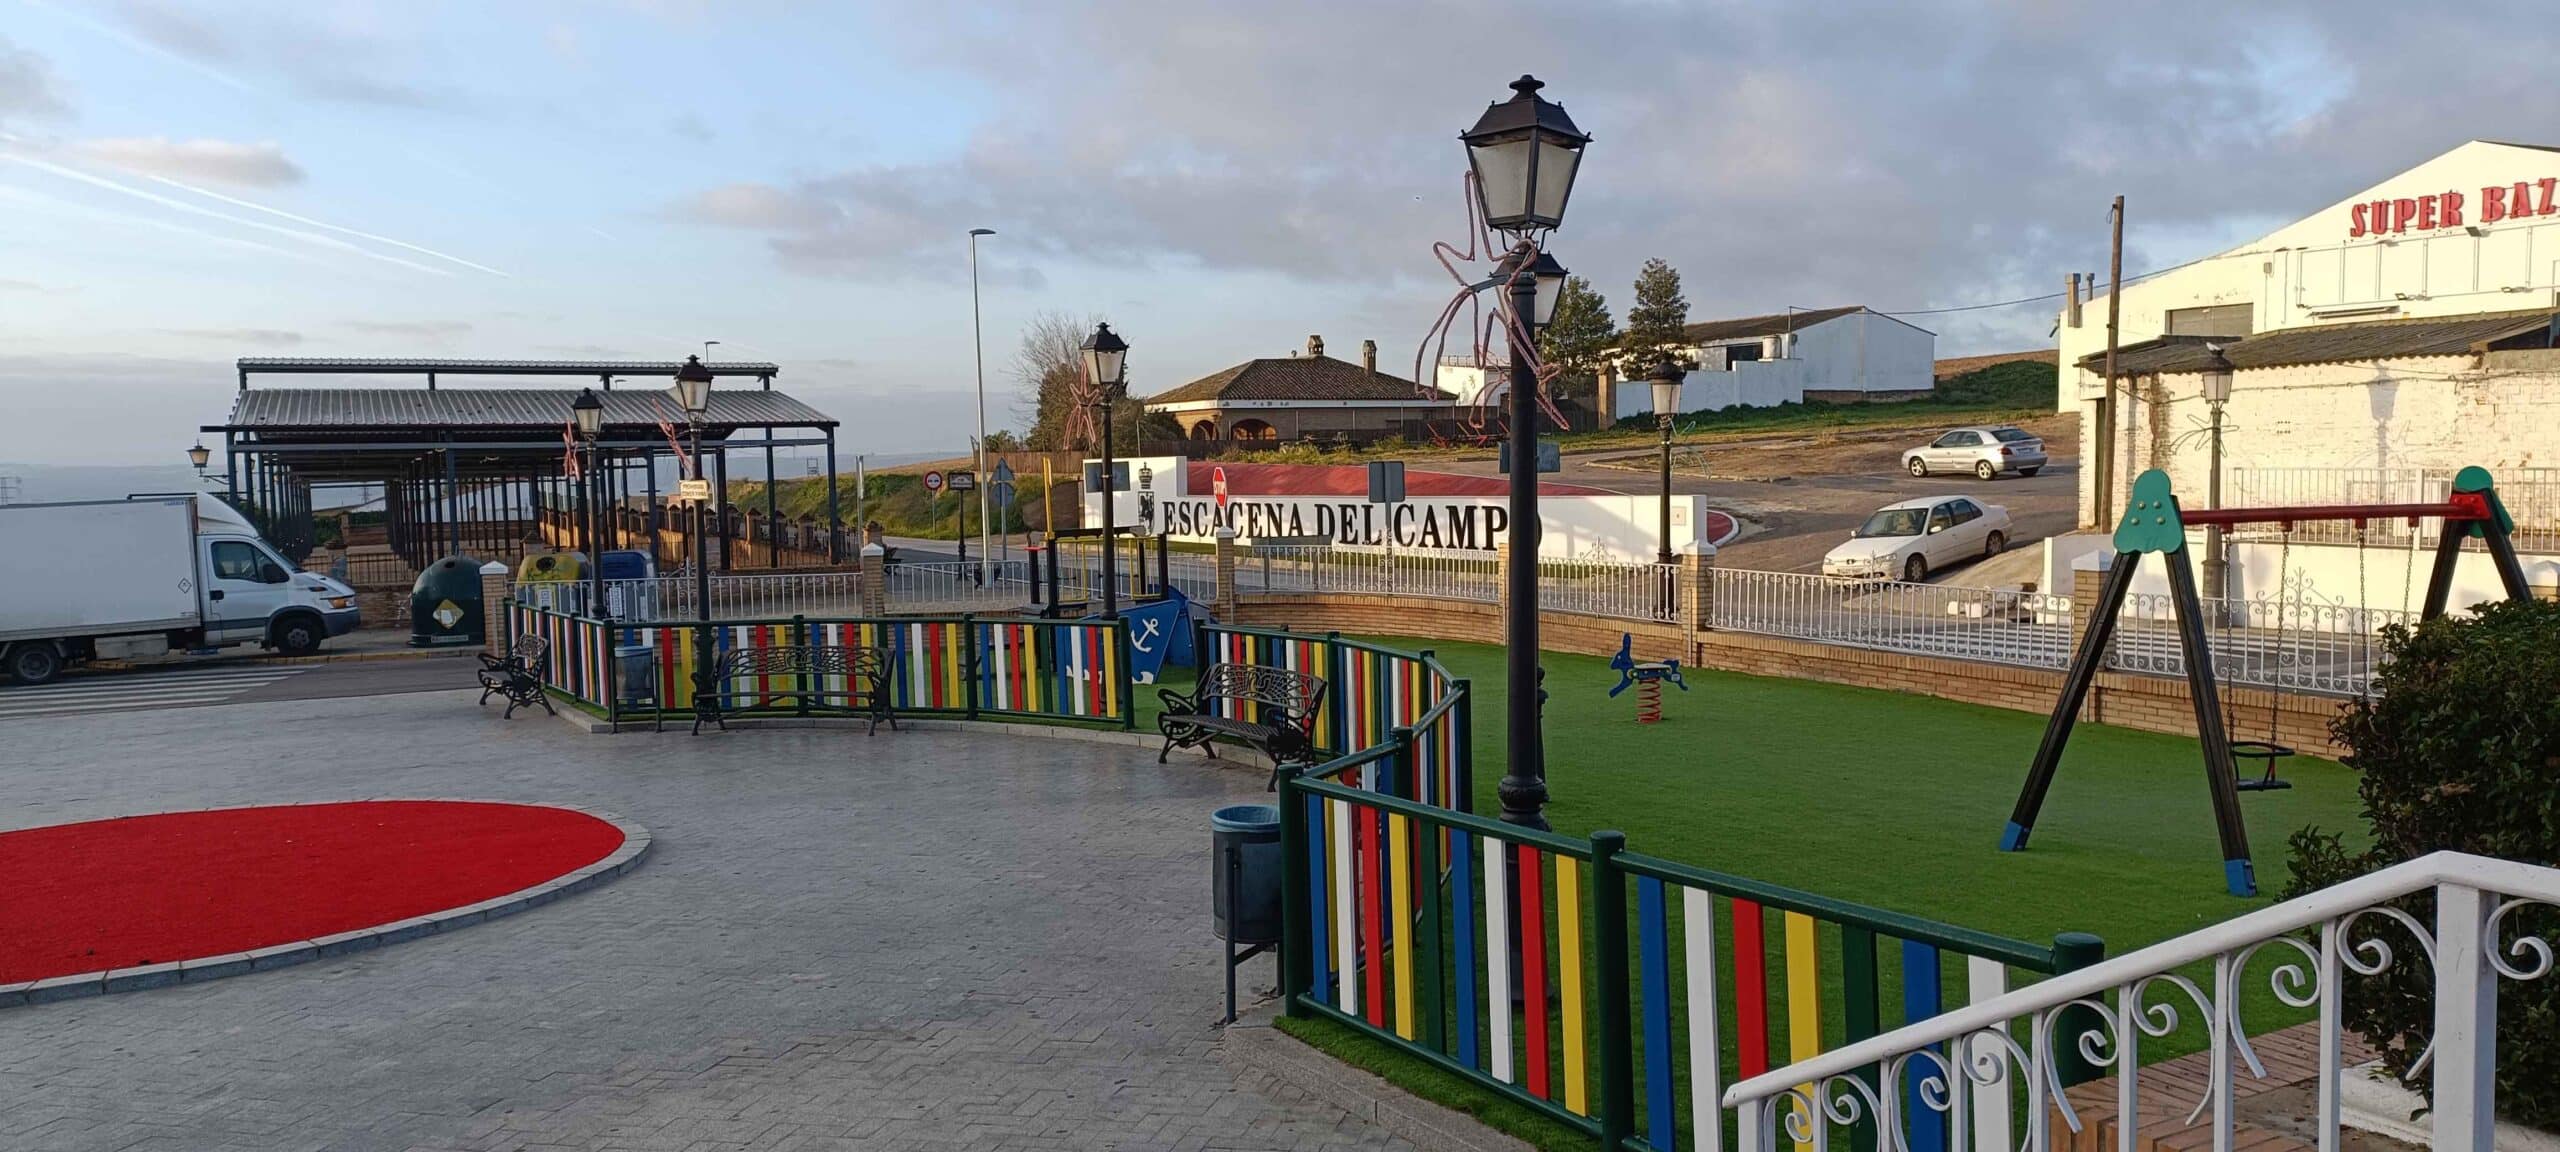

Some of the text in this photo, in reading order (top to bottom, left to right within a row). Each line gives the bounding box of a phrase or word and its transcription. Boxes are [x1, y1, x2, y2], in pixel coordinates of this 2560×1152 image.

[2350, 177, 2557, 238] SUPER BAZ
[1162, 500, 1543, 551] ESCACENA DEL CAMP
